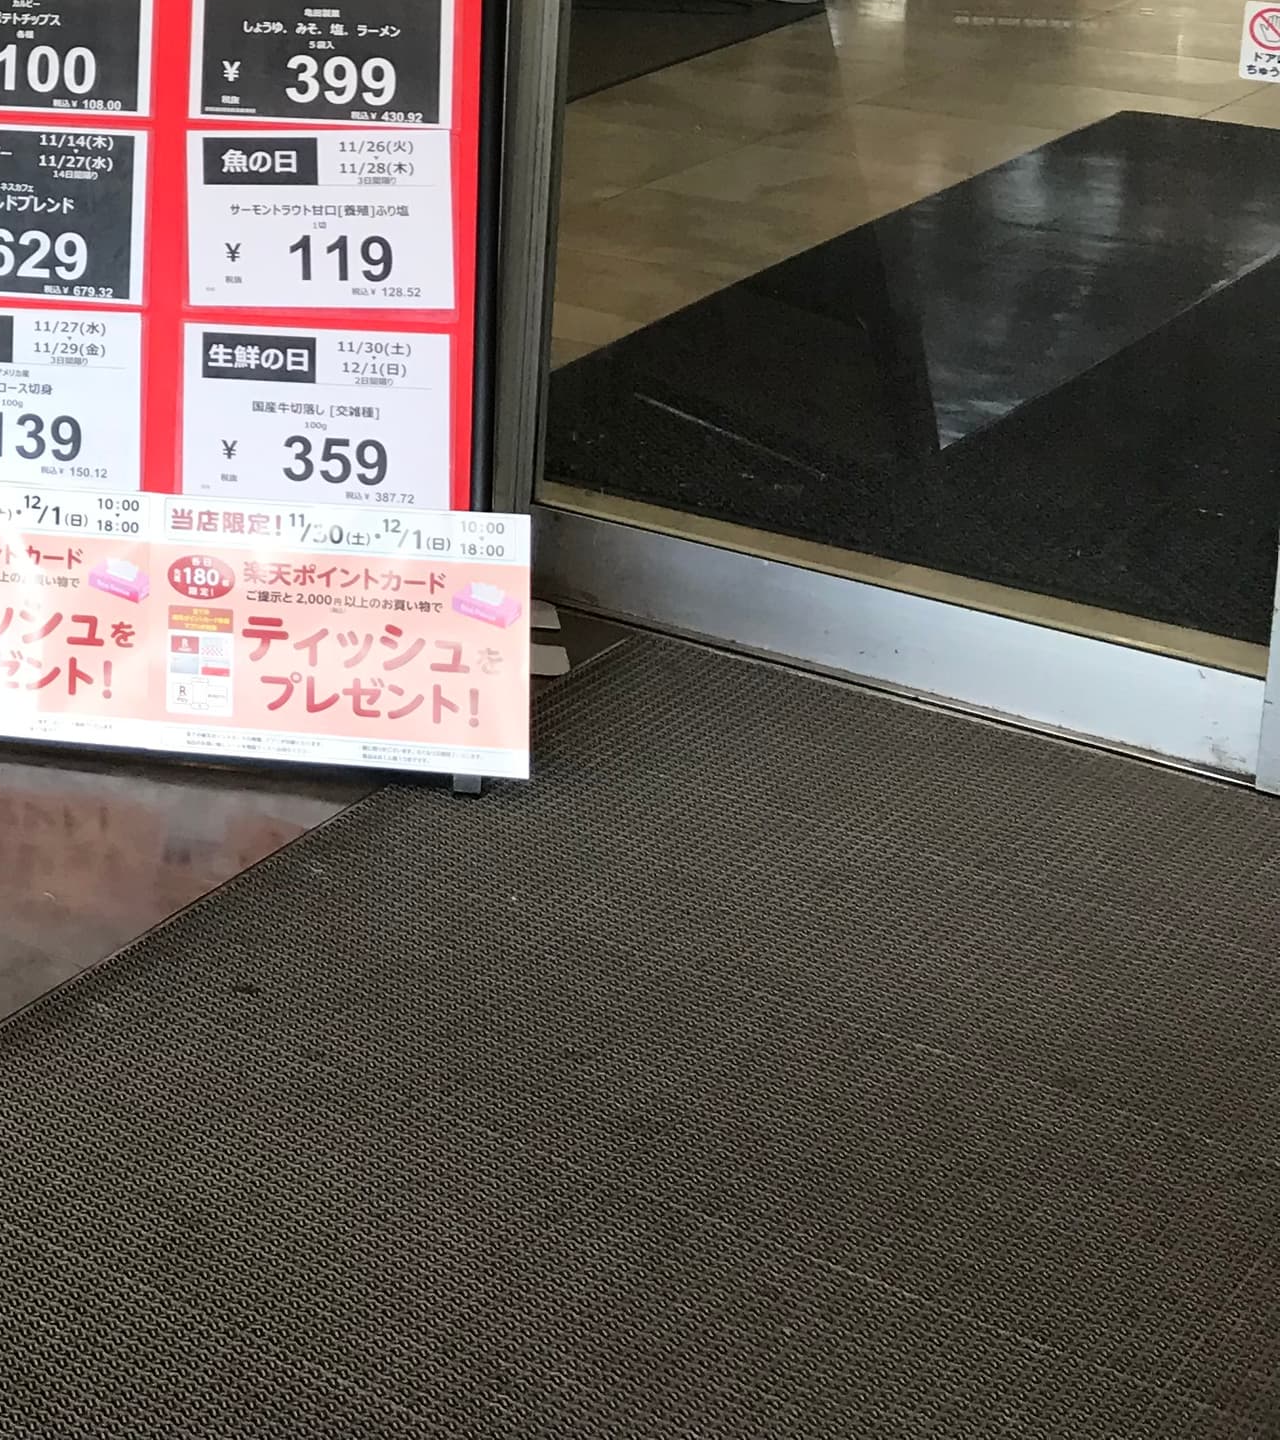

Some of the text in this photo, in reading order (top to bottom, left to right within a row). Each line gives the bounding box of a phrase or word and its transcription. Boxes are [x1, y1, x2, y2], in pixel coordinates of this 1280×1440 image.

[12, 0, 40, 8] カルビー
[222, 55, 396, 106] ¥ 399
[82, 100, 121, 110] 108.00
[381, 112, 422, 123] 430.92
[39, 135, 113, 150] 11/14(木)
[339, 141, 414, 154] 11/26(火)
[39, 155, 113, 171] 11/27(水)
[222, 149, 297, 173] 魚の日
[339, 162, 414, 175] 11/28(木)
[0, 182, 34, 192] ネスカフェ
[230, 204, 409, 217] サーモントラウト甘口[養殖]ふり塩
[225, 235, 393, 282] ¥ 119
[73, 286, 113, 297] 679.32
[382, 287, 421, 297] 128.52
[34, 320, 106, 336] 11/27(水)
[33, 342, 106, 357] 11/29(金)
[337, 341, 412, 356] 11/30(土)
[208, 344, 309, 372] 生鮮の日
[342, 363, 407, 377] 12/1(日)
[1, 399, 23, 408] 100g
[252, 401, 324, 416] 国産牛切落し
[305, 421, 327, 430] 100g
[222, 435, 388, 485] ¥ 359
[70, 467, 107, 478] 150.12
[98, 498, 139, 512] 10:00
[375, 493, 414, 504] 387.72
[97, 519, 139, 533] 18:00
[171, 508, 281, 537] 当店限定!
[461, 521, 505, 534] 10:00
[460, 543, 505, 557] 18:00
[183, 567, 219, 588] 180
[243, 562, 446, 594] 楽天ポイントカード
[246, 591, 292, 603] ご提示と
[242, 616, 504, 674] ティッシュを
[261, 672, 480, 728] プレゼント!
